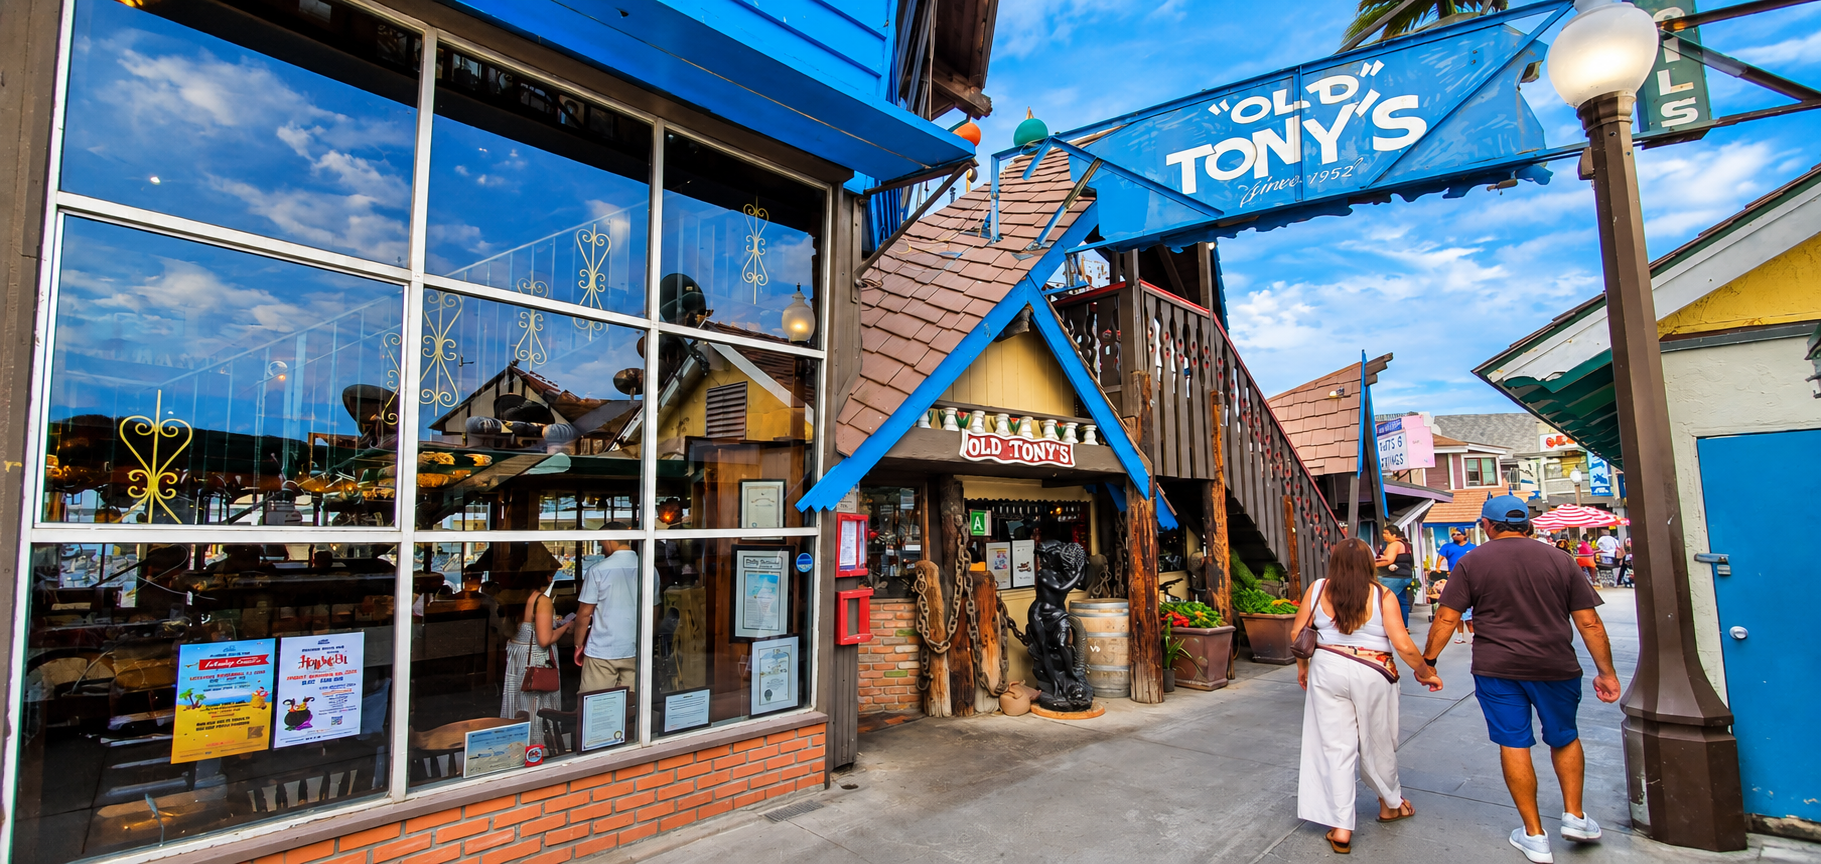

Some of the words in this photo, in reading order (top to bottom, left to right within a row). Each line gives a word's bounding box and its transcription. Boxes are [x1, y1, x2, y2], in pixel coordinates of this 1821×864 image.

[1166, 89, 1427, 195] TONY'S
[1308, 157, 1364, 186] 1952
[968, 437, 1002, 456] OLD
[1009, 440, 1070, 463] TONY'S
[973, 516, 983, 531] A
